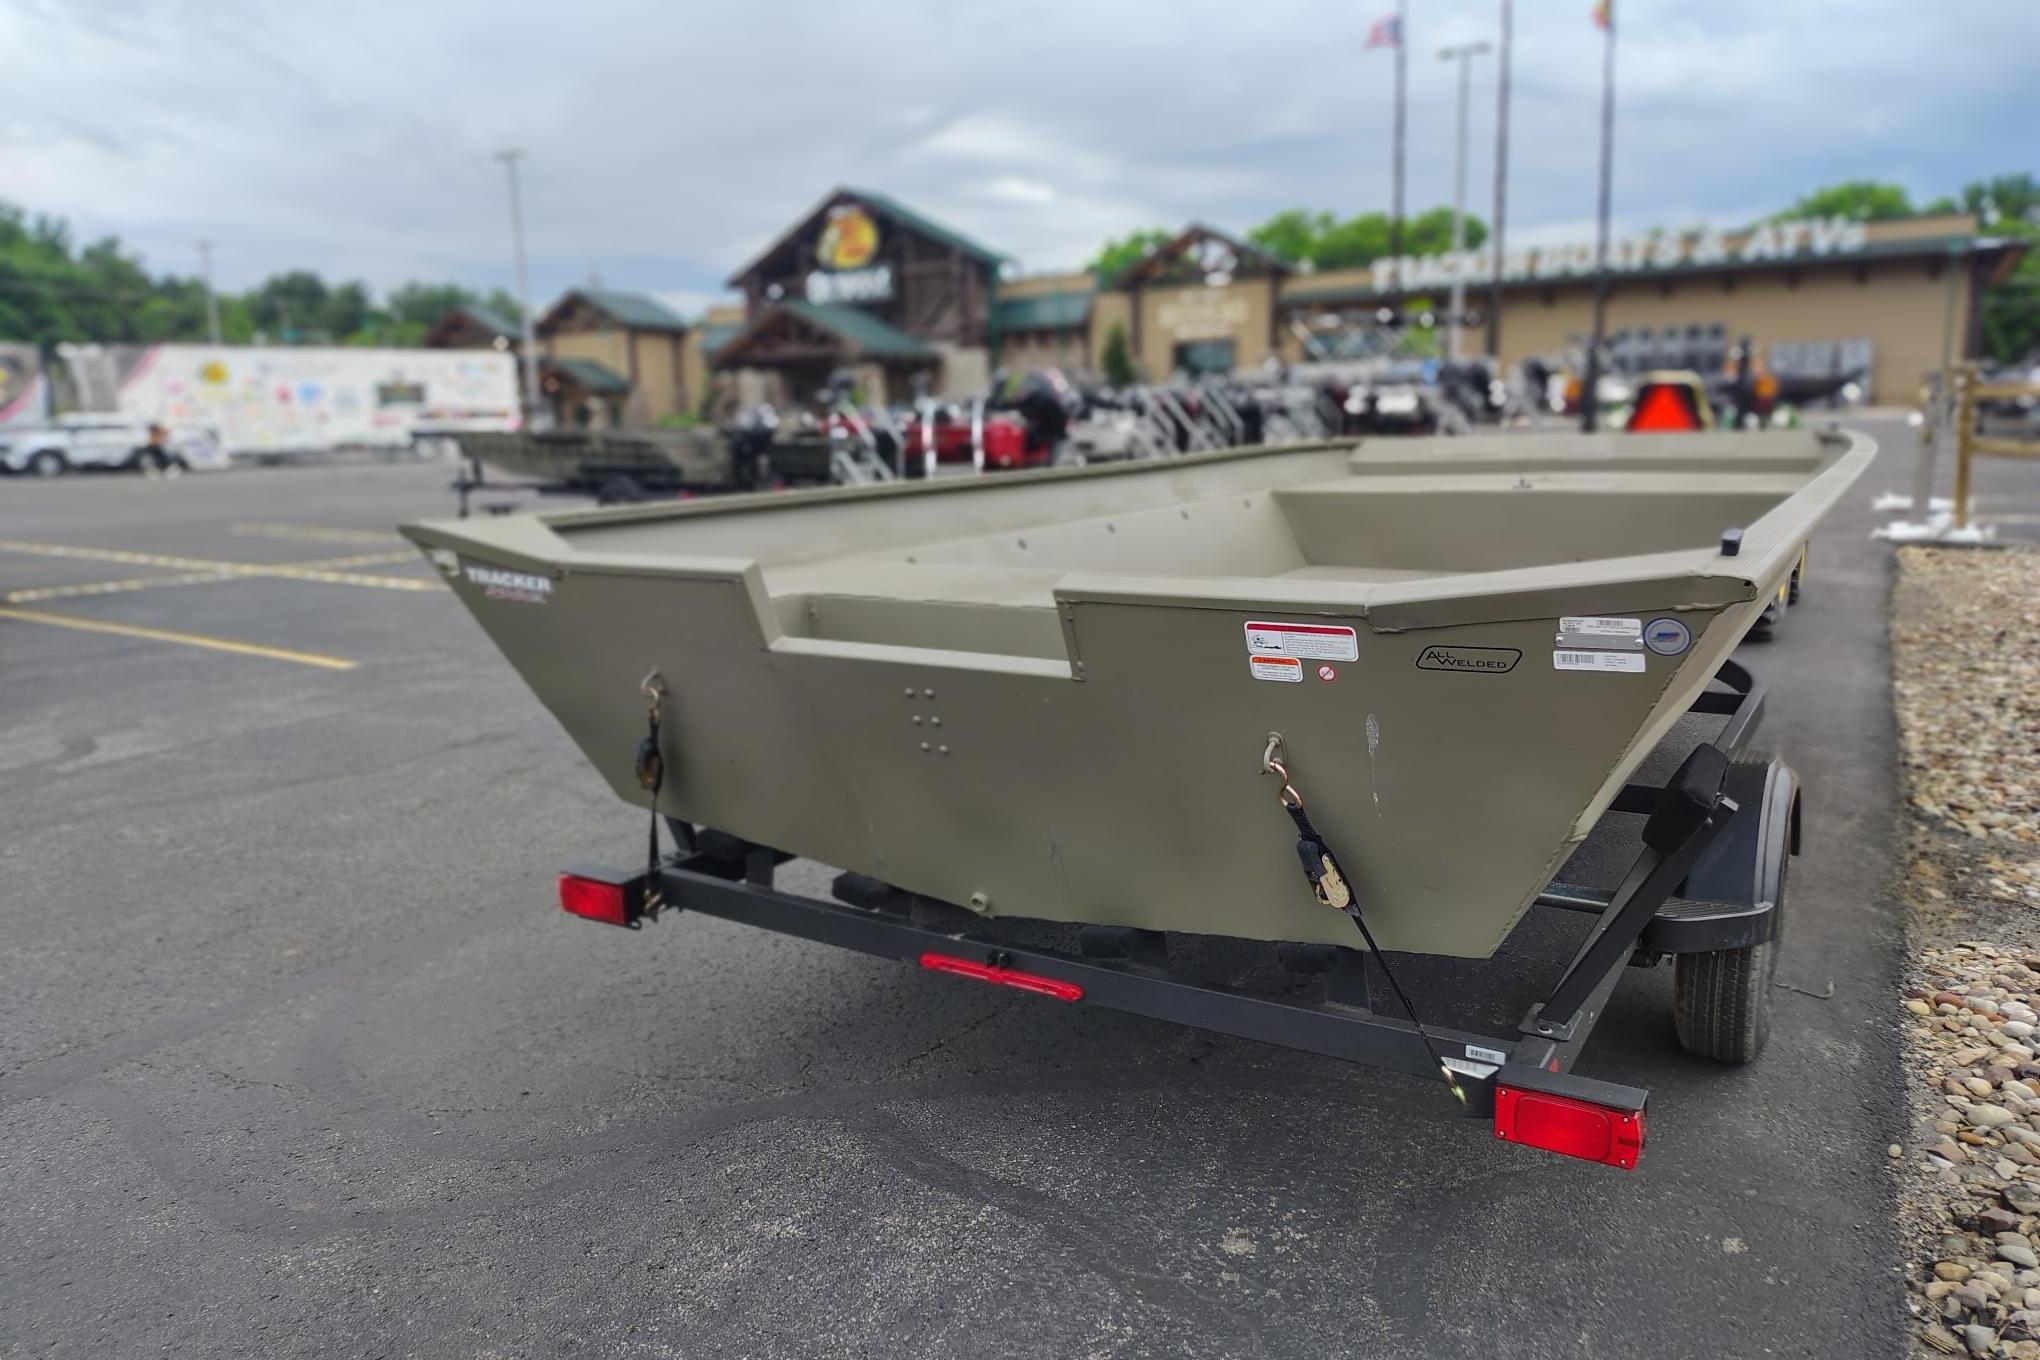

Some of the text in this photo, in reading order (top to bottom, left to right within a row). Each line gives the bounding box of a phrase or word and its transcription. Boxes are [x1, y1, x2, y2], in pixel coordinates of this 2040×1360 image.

[466, 567, 552, 592] TRACKER
[1426, 651, 1455, 660] ALL
[1437, 658, 1507, 668] WELDED
